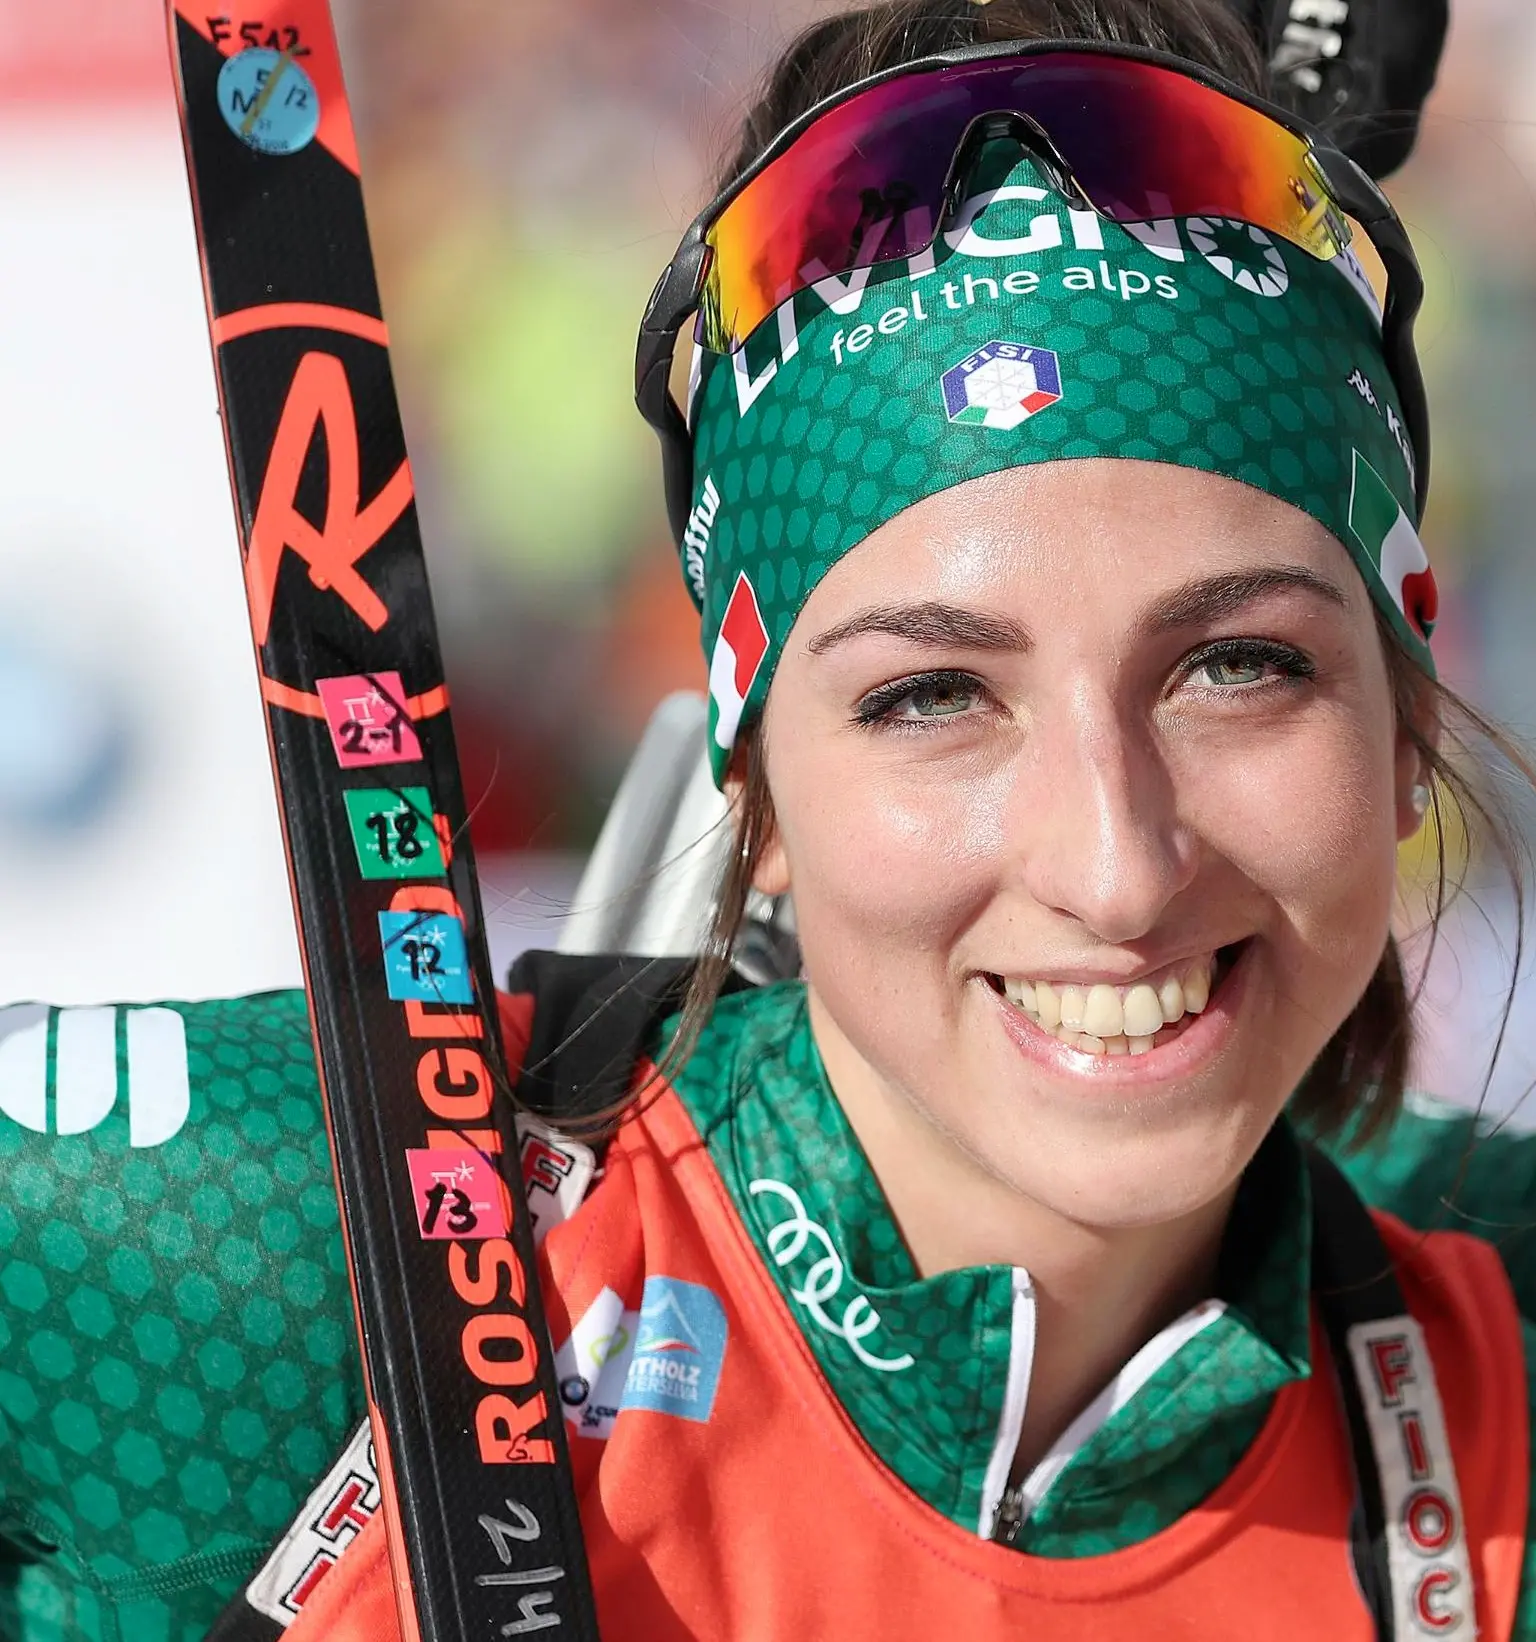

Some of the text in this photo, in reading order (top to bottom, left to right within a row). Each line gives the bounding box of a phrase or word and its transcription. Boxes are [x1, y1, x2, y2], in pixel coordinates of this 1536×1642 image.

[830, 260, 1179, 366] feel the alps
[960, 343, 1034, 373] FISI
[366, 811, 424, 864] 18
[422, 1181, 478, 1235] 13
